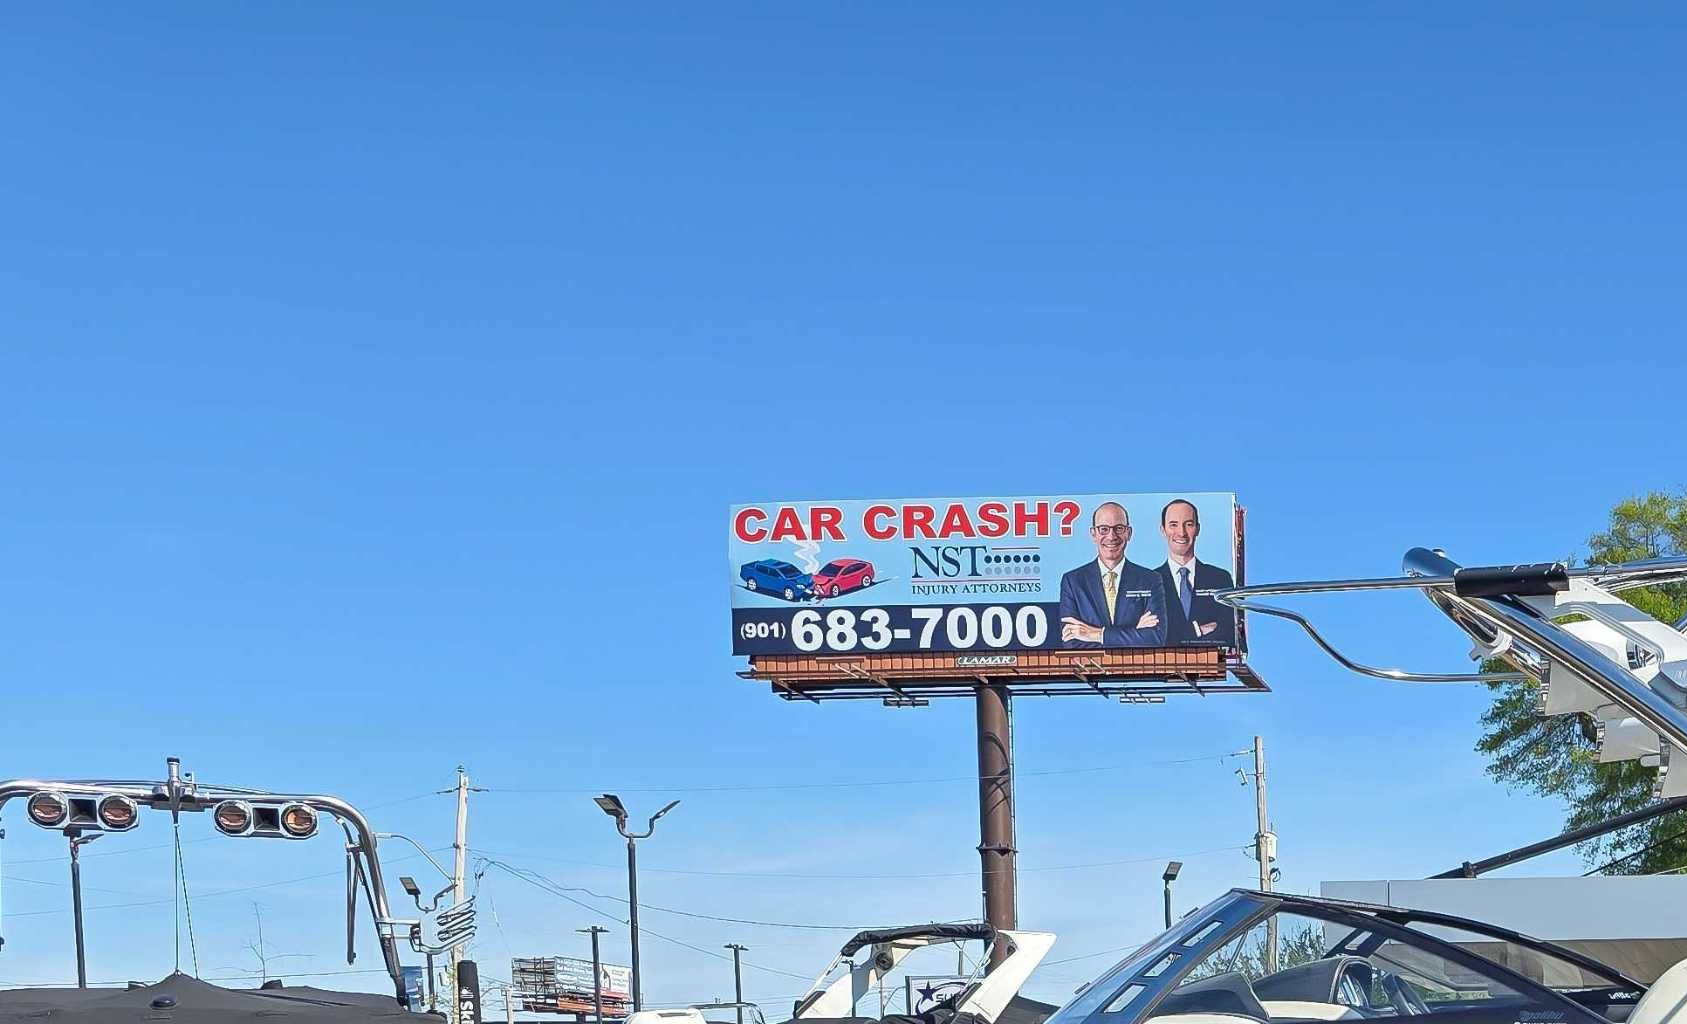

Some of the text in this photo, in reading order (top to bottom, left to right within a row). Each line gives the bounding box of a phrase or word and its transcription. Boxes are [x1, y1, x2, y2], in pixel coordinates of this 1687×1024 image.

[734, 501, 1081, 543] CAR CRASH?
[910, 546, 987, 578] NST
[912, 583, 1041, 595] INJURY ATTORNEYS
[740, 605, 1048, 651] (901) 683-7000
